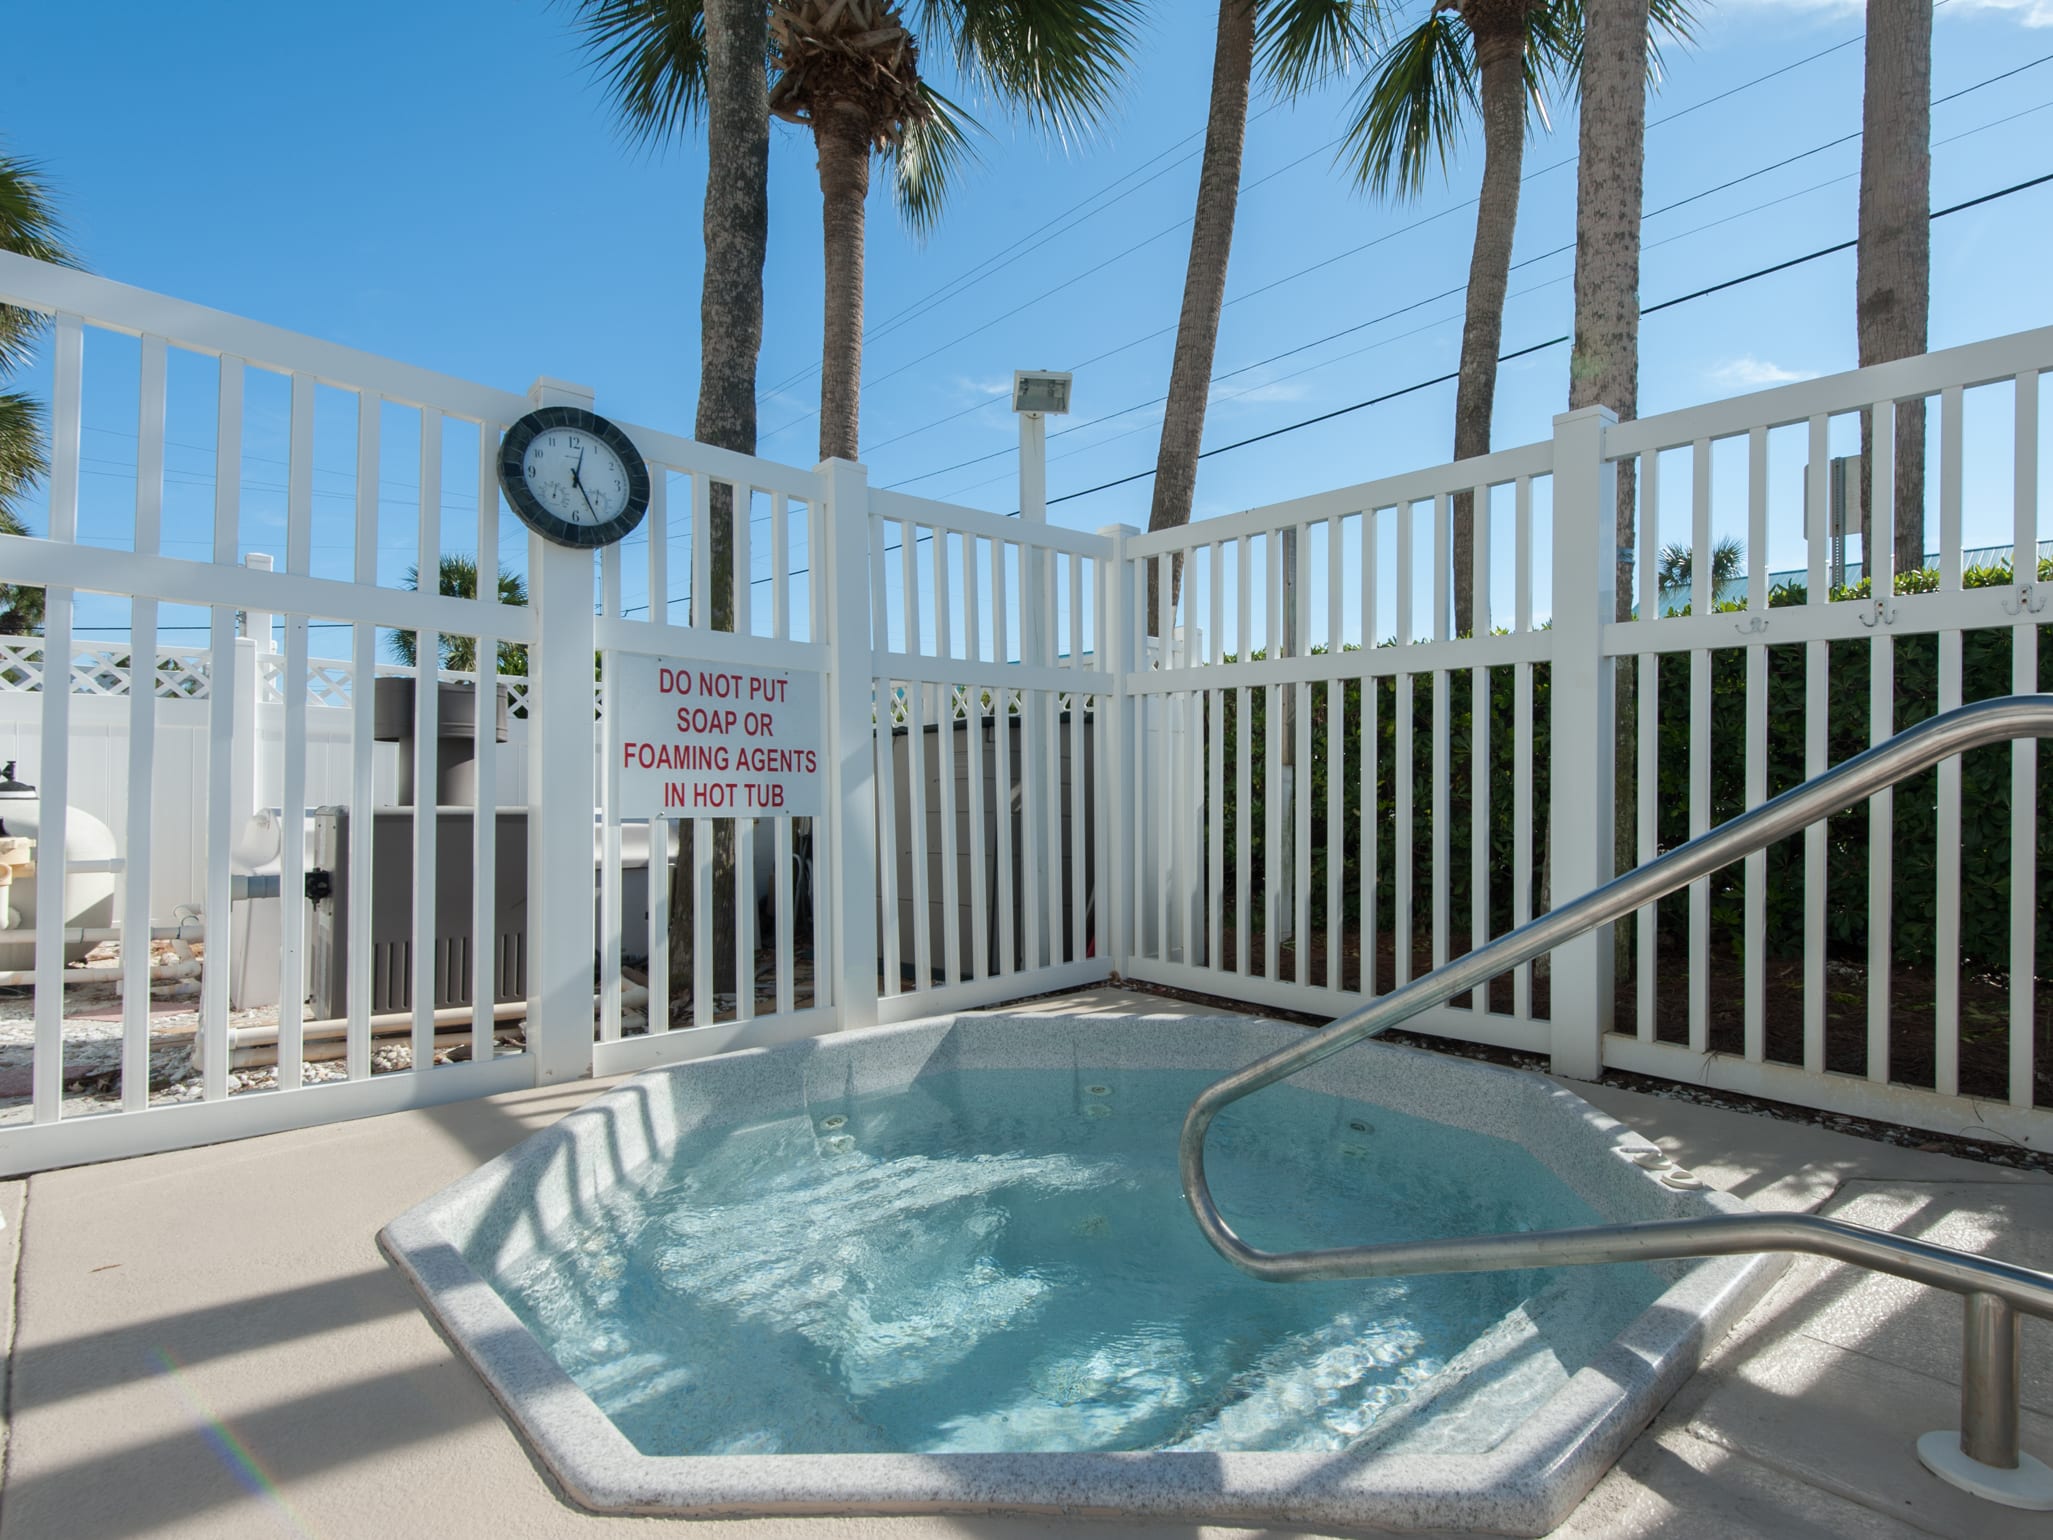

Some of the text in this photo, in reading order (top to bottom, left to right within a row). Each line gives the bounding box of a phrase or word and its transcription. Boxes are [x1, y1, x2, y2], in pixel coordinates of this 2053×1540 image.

[548, 438, 556, 447] 11
[569, 436, 581, 450] 12
[534, 449, 543, 458] 10
[528, 465, 536, 478] 9
[609, 462, 615, 471] 2
[614, 480, 620, 492] 3
[572, 511, 580, 522] 6
[659, 668, 788, 702] DO NOT PUT
[677, 707, 773, 736] SOAP OR
[624, 741, 816, 774] FOAMING AGENTS
[664, 782, 784, 808] IN HOT TUB
